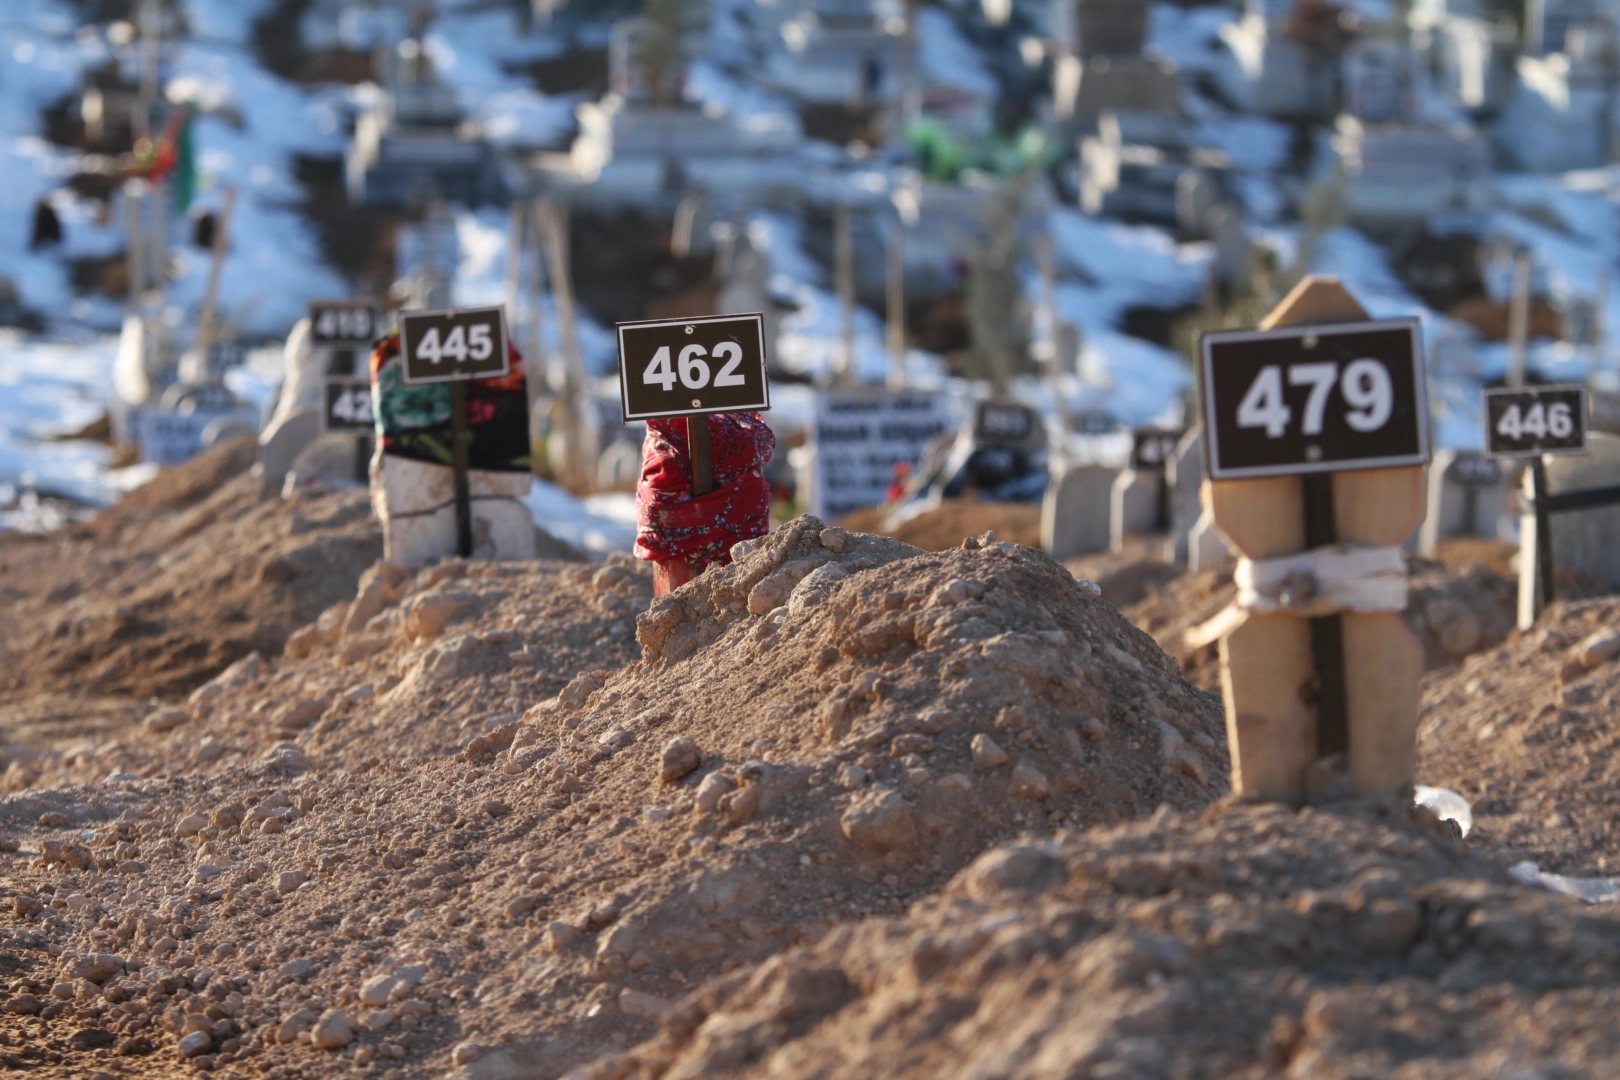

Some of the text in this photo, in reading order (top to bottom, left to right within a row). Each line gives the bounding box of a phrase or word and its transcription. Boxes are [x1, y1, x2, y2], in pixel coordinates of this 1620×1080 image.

[416, 323, 493, 364] 445
[642, 341, 746, 392] 462
[1237, 360, 1393, 437] 479
[1497, 402, 1574, 441] 446
